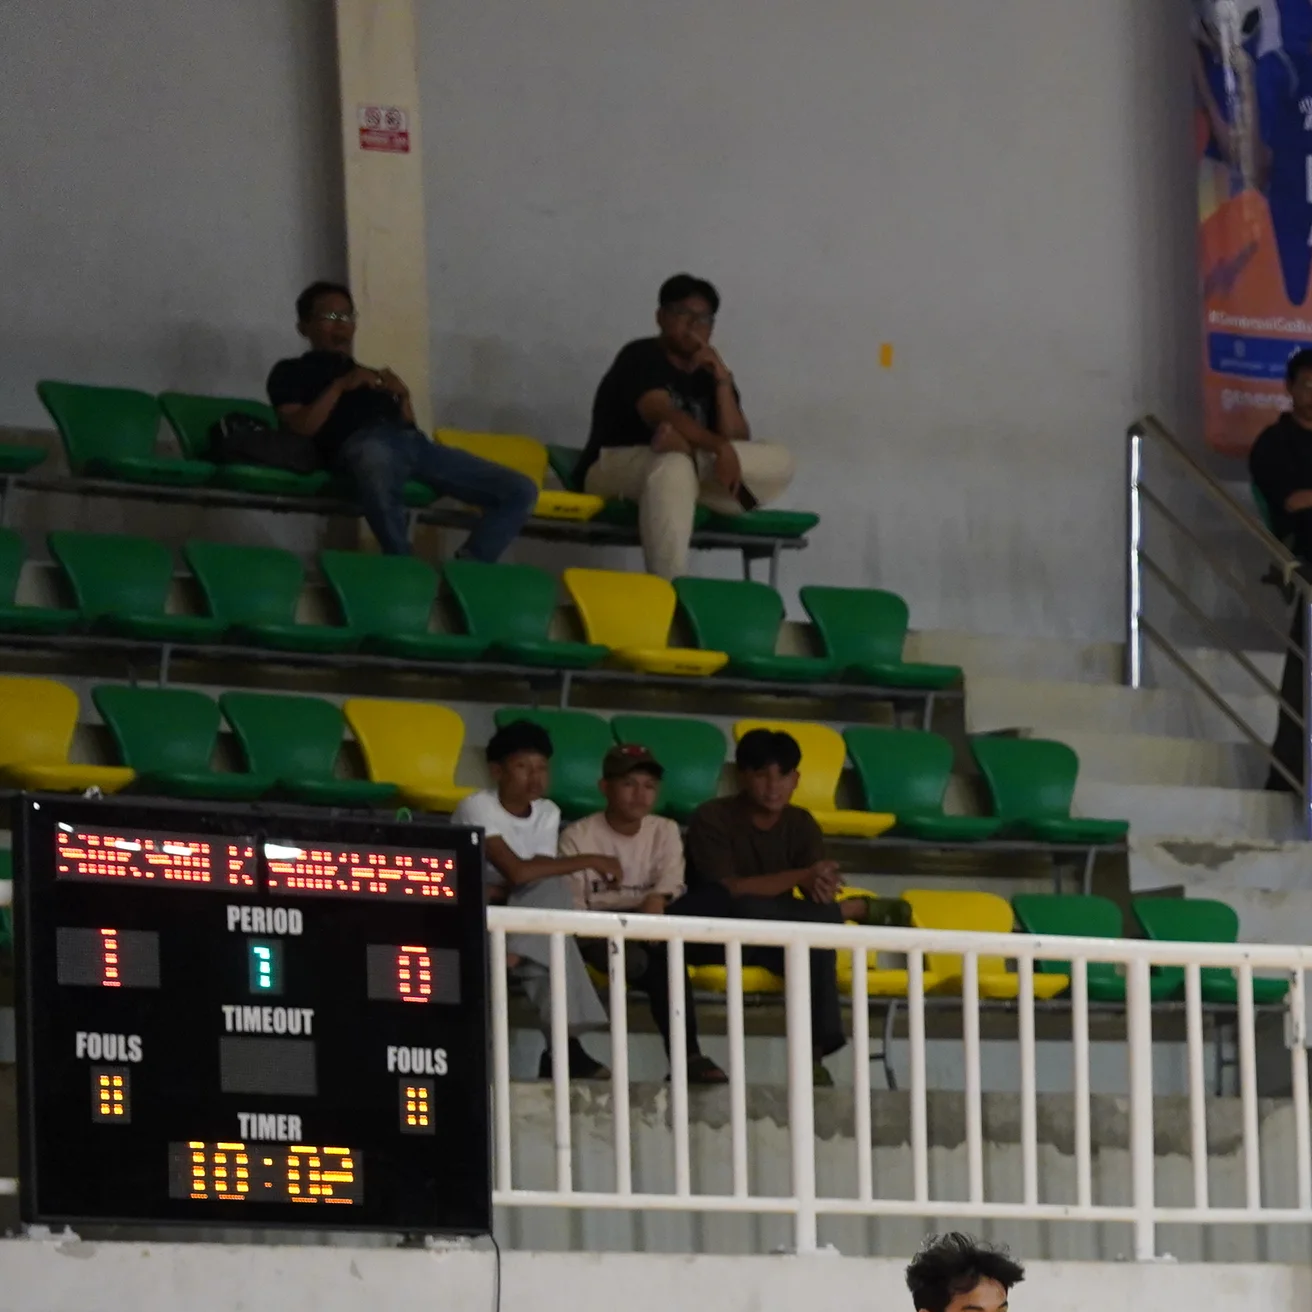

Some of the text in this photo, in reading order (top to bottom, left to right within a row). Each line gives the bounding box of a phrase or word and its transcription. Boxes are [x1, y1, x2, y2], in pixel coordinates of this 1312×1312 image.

[227, 905, 304, 935] PERIOD
[100, 928, 122, 986] 1
[398, 946, 431, 1003] 0
[222, 1004, 314, 1035] TIMEOUT
[76, 1032, 143, 1062] FOULS
[387, 1045, 448, 1075] FOULS
[237, 1112, 304, 1141] TIMER
[189, 1141, 354, 1205] 10:02
